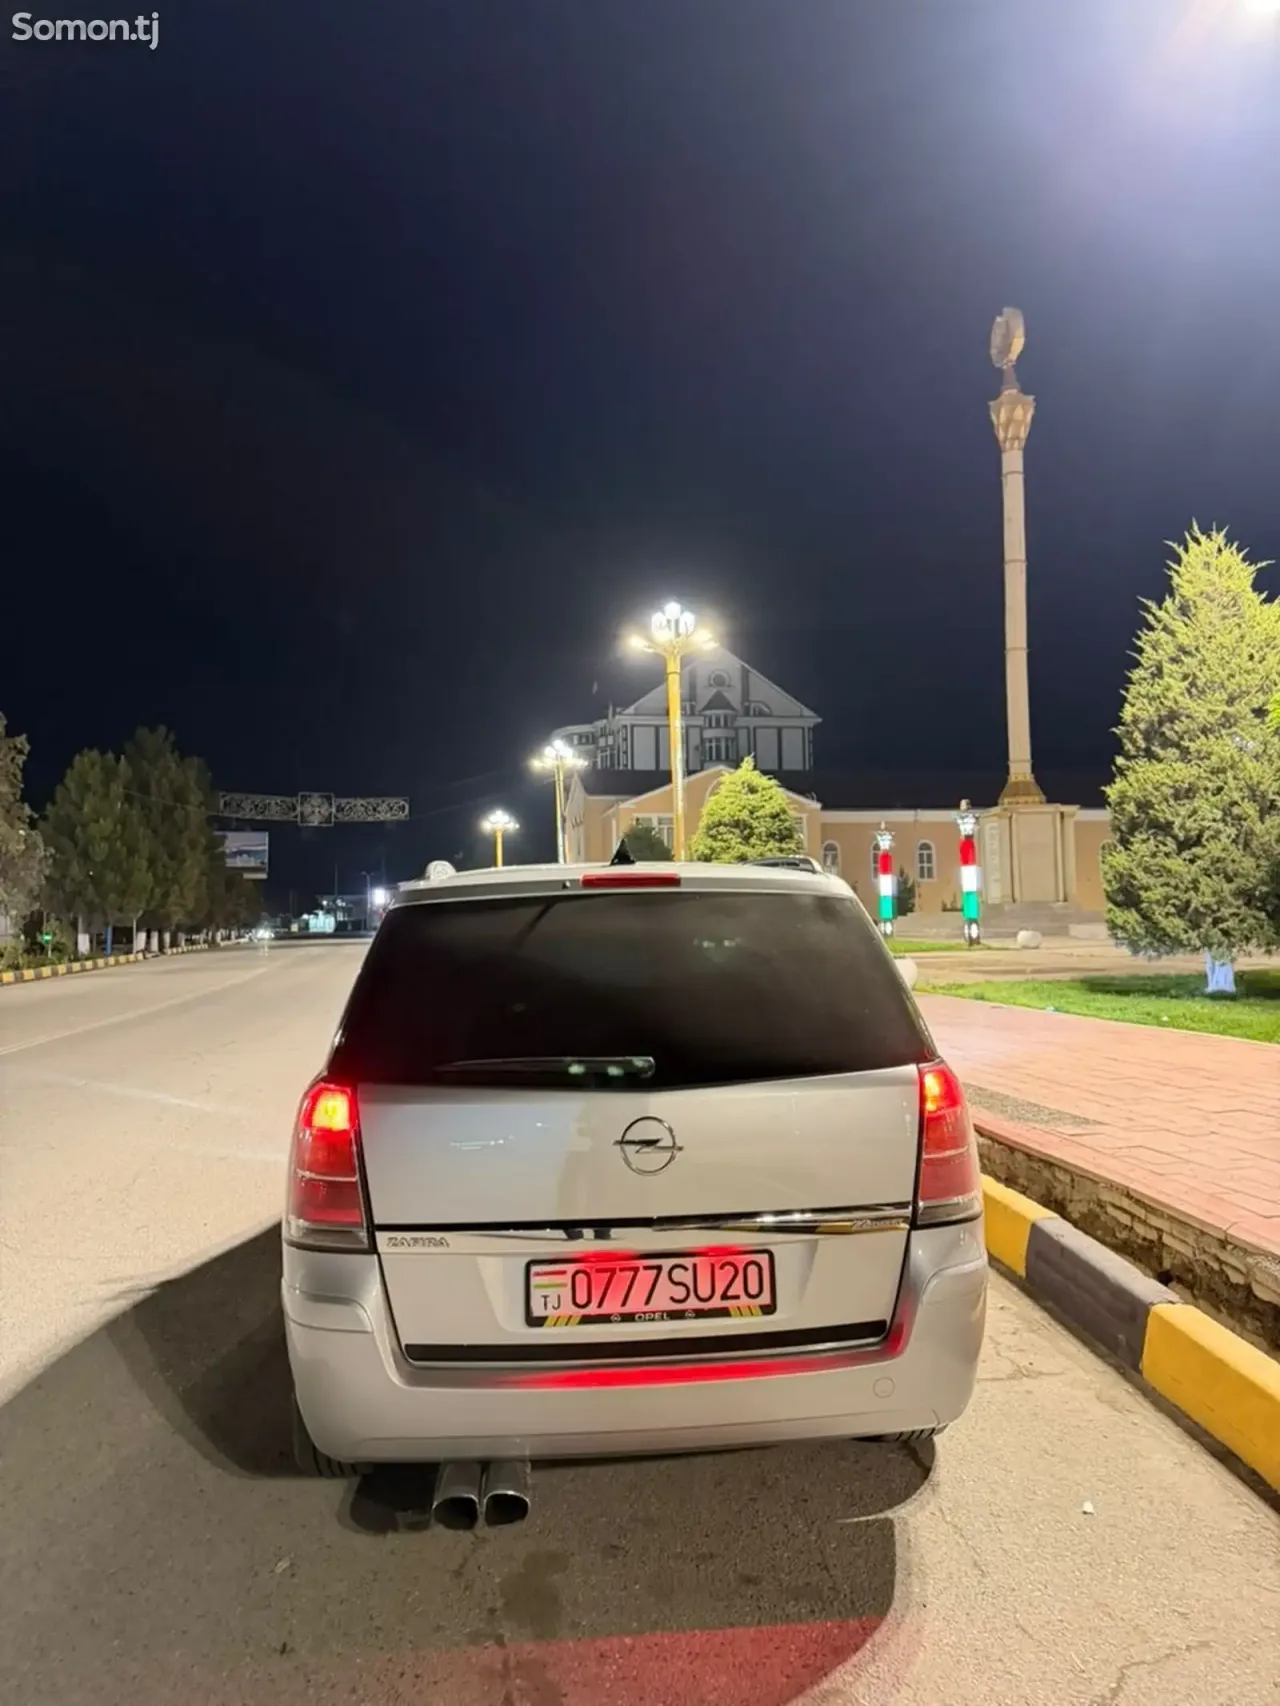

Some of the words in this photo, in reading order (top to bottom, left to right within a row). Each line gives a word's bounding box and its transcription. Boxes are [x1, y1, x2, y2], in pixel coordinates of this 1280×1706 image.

[541, 1294, 561, 1311] TJ
[571, 1260, 764, 1309] 0777SU20
[634, 1312, 671, 1323] OPEL
